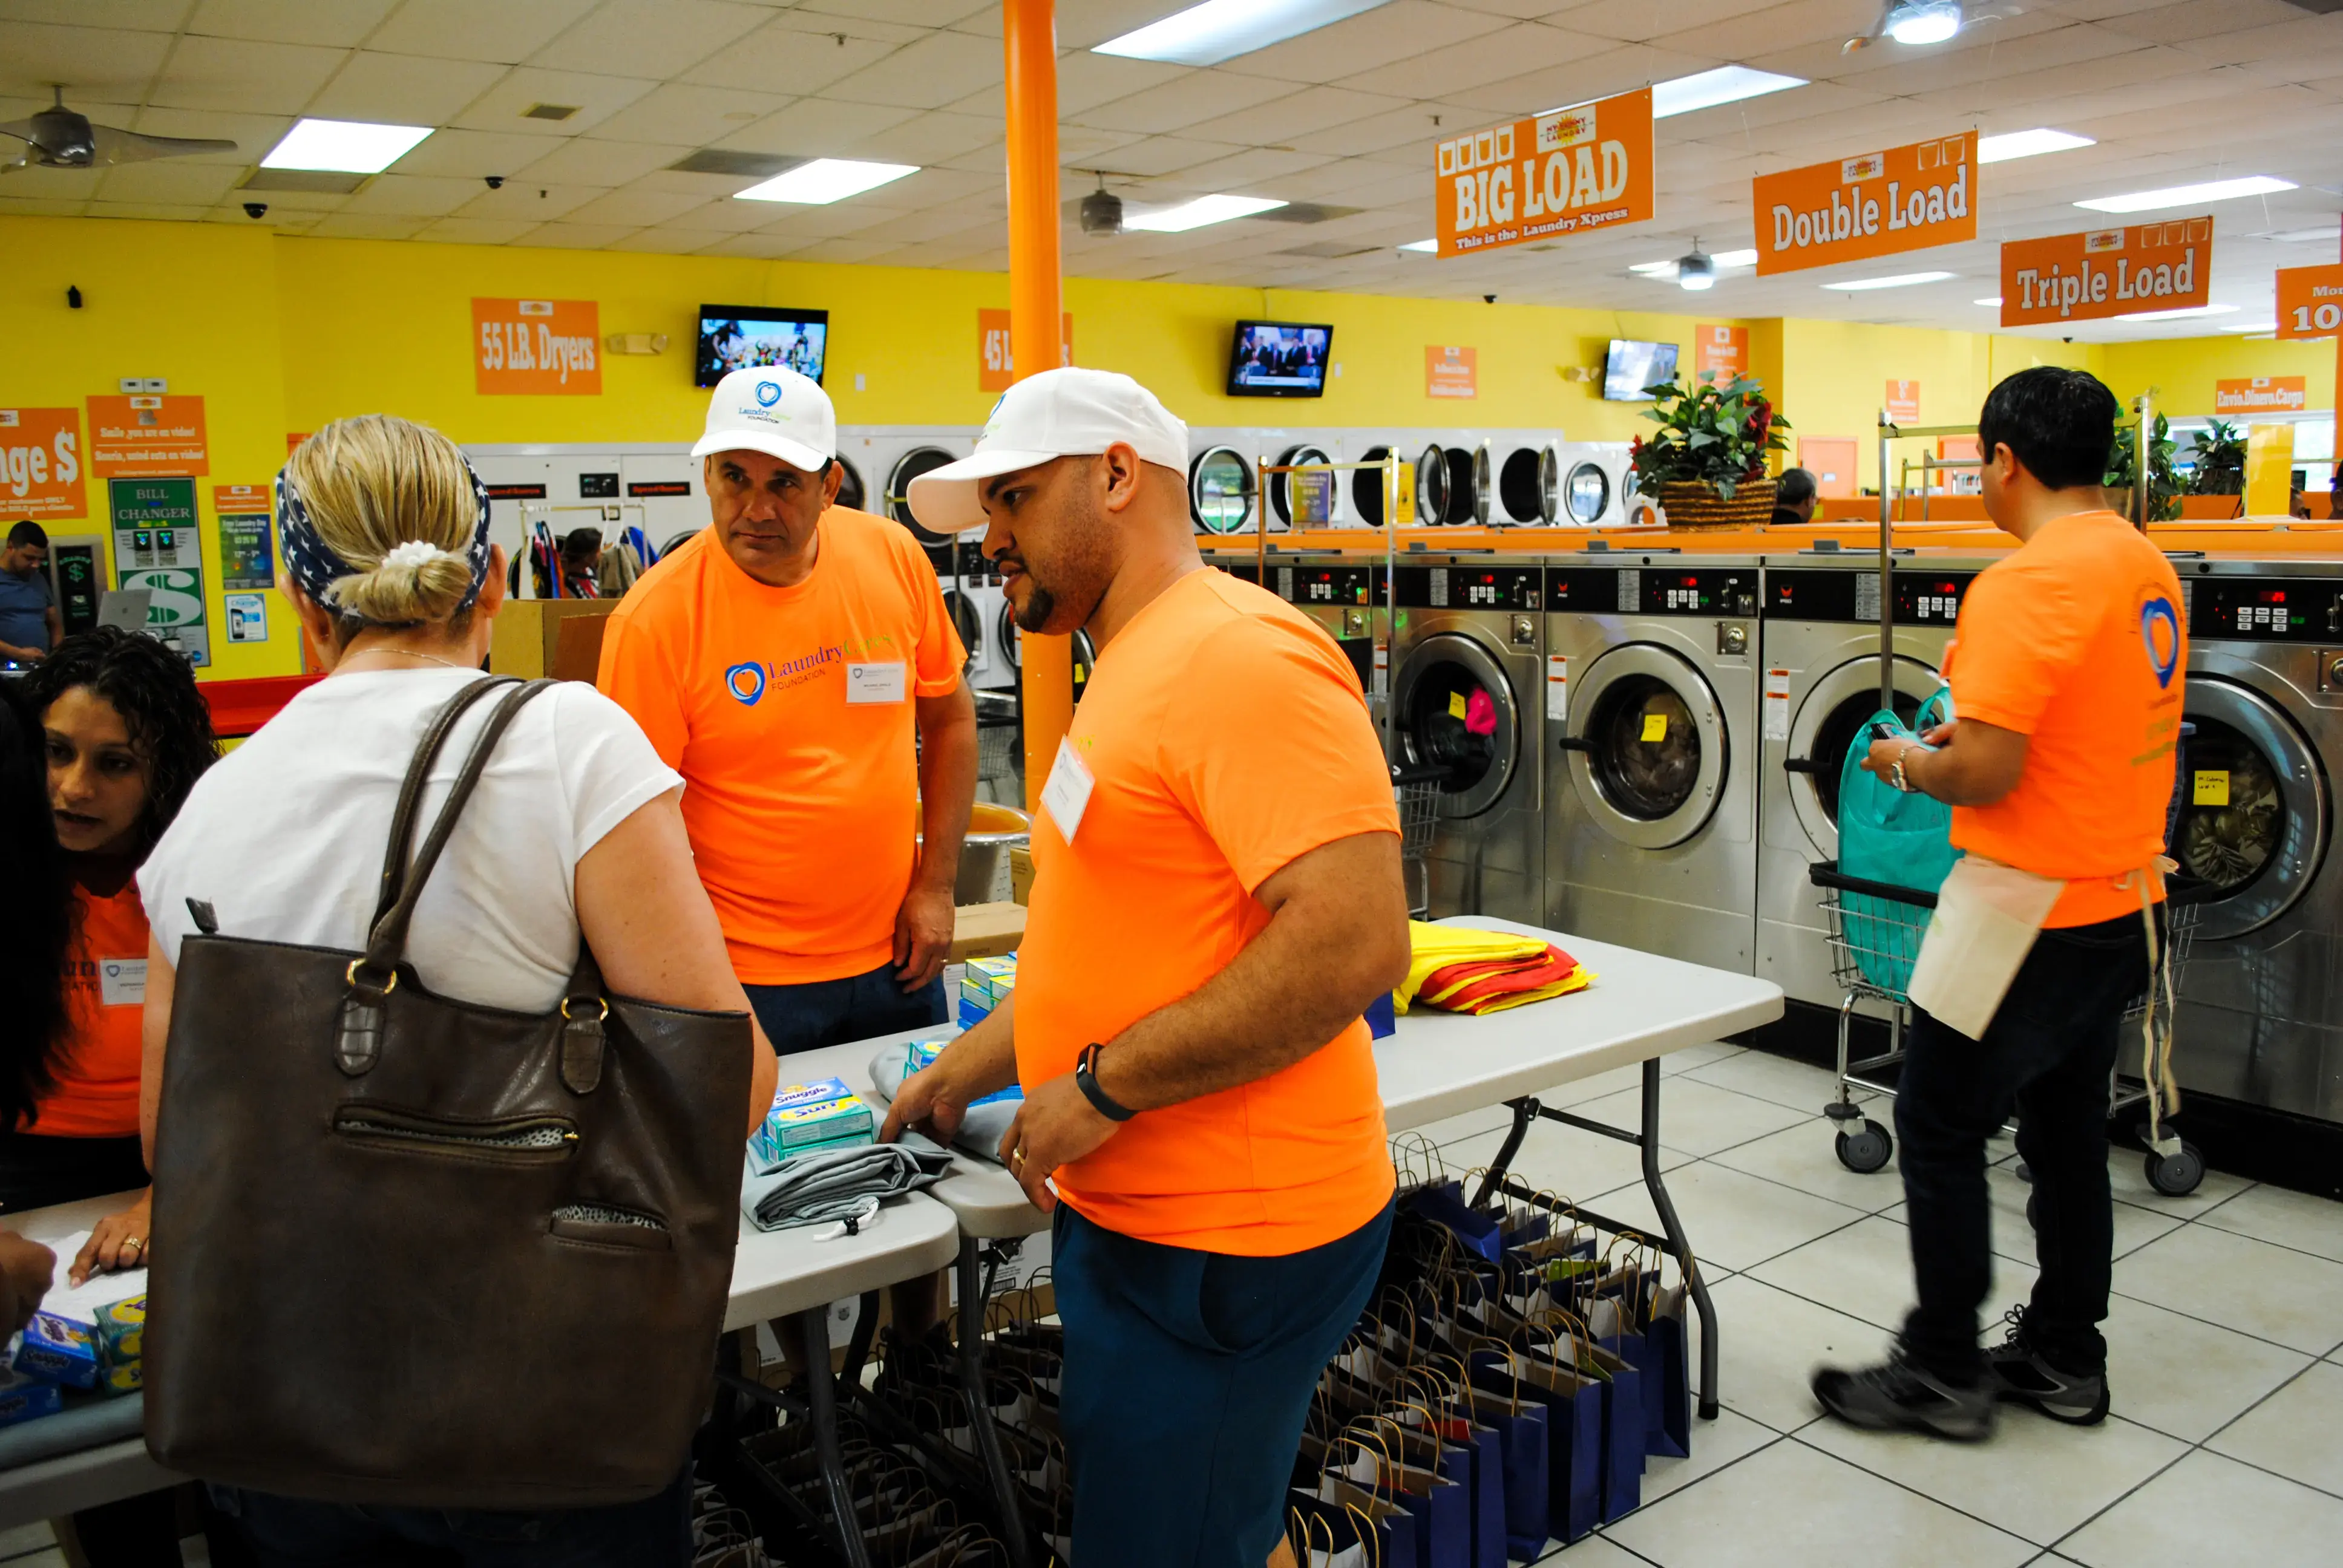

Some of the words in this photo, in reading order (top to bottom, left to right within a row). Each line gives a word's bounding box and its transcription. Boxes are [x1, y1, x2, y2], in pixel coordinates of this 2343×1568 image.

[1547, 127, 1586, 143] LAUNDRY
[1455, 165, 1515, 232] BIG
[1522, 139, 1628, 218] LOAD
[1772, 185, 1880, 252] Double
[1887, 163, 1968, 231] Load
[1456, 235, 1483, 250] This
[1484, 232, 1496, 245] is
[1498, 229, 1518, 242] the
[1522, 217, 1578, 237] Laundry
[1579, 207, 1629, 227] Xpress
[2017, 259, 2108, 318] Triple
[2115, 247, 2195, 300] Load
[2292, 303, 2343, 332] 10
[482, 322, 503, 370] 55
[537, 322, 595, 385] Dryers
[984, 329, 1002, 371] 45
[136, 489, 169, 500] BILL
[118, 508, 191, 520] CHANGER
[772, 668, 825, 691] FOUNDATION
[776, 1086, 827, 1104] Snuggle
